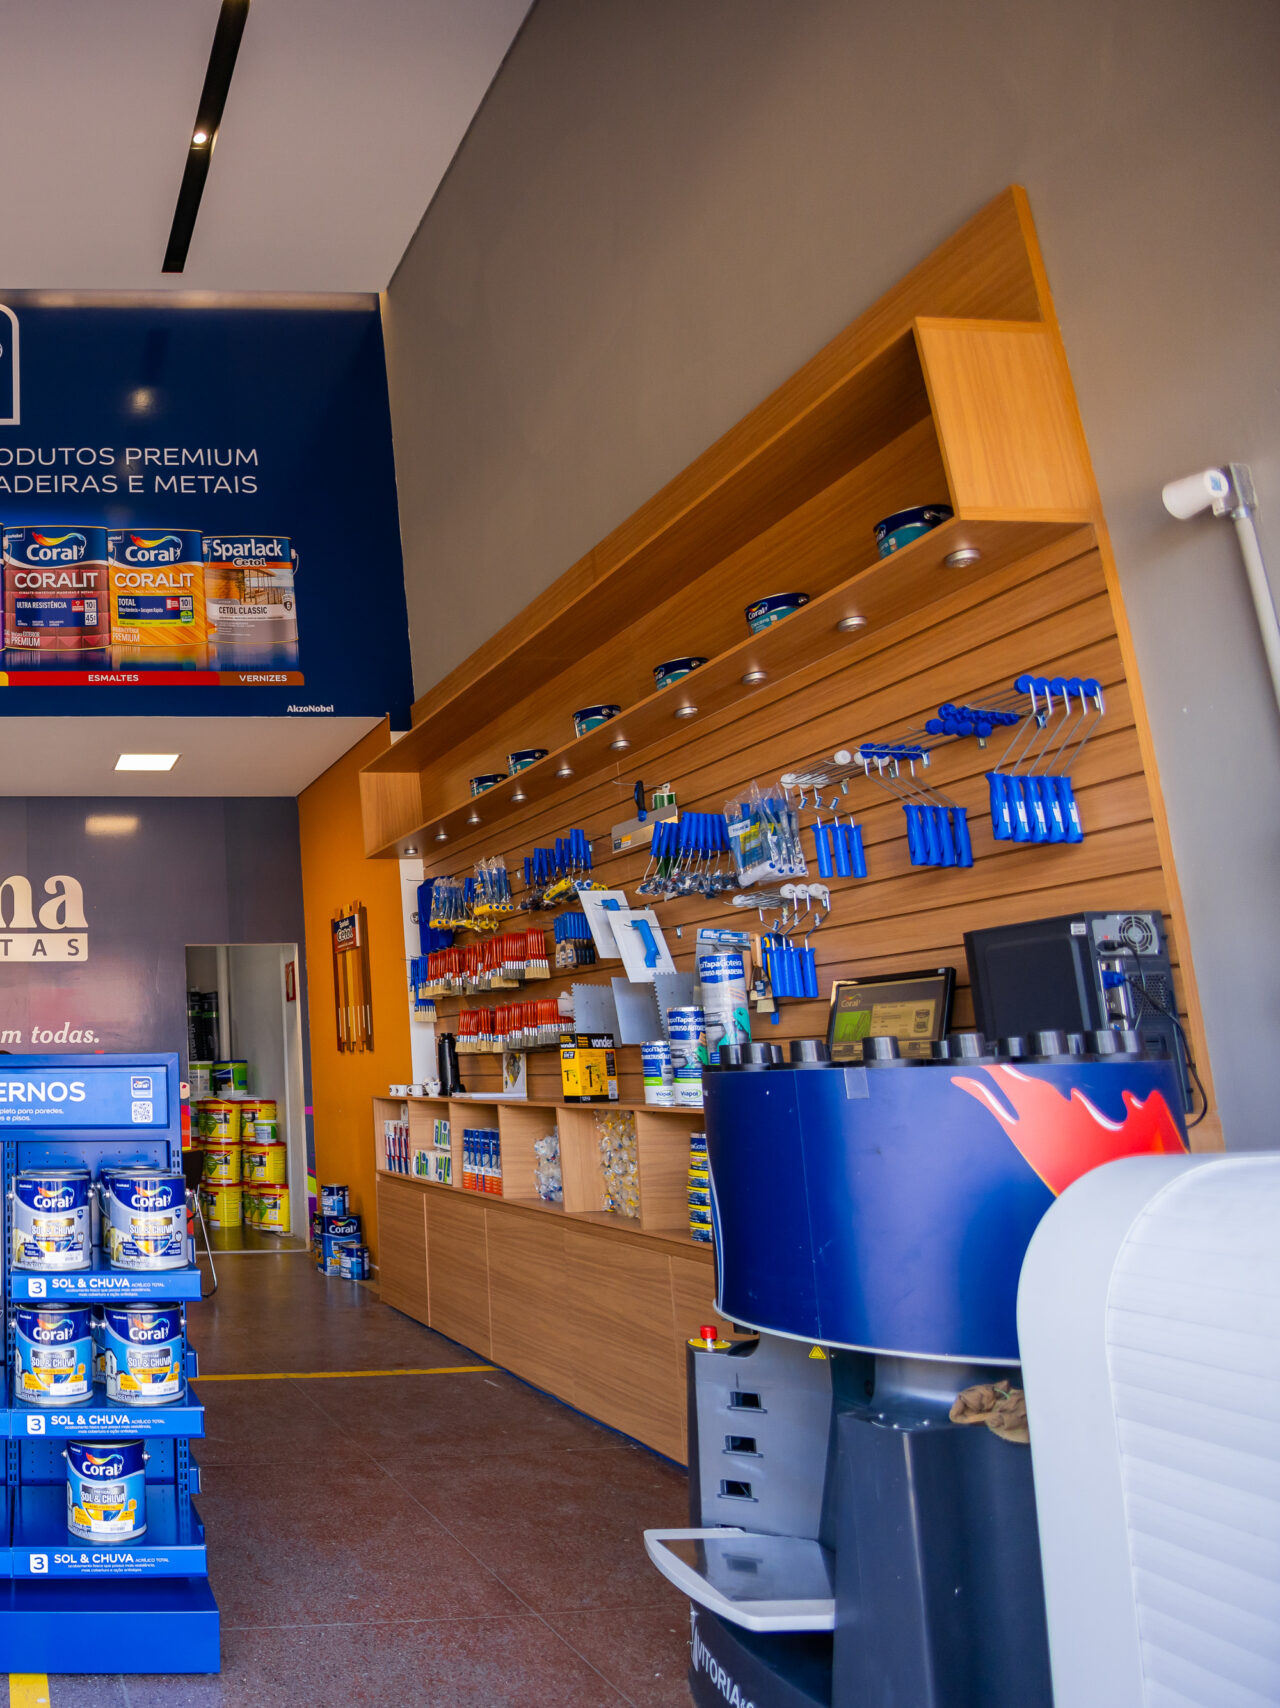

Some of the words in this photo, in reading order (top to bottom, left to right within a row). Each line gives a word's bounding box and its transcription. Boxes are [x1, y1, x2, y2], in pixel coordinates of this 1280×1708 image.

[125, 447, 259, 466] PREMIUM
[127, 475, 144, 493] E
[154, 475, 258, 494] METAIS
[26, 544, 78, 561] Coral
[125, 546, 175, 562] Coral
[212, 538, 283, 560] Sparlack
[232, 558, 267, 567] Cetol
[14, 572, 99, 589] CORALIT
[114, 572, 194, 589] CORALIT
[16, 601, 32, 609] ULTRA
[32, 599, 67, 609] RESISTÊNCIA
[118, 598, 136, 607] TOTAL
[218, 606, 238, 615] CETOL
[238, 606, 268, 615] CLASSIC
[88, 674, 139, 682] ESMALTES
[239, 674, 288, 682] VERNIZES
[287, 704, 334, 713] AkzoNobel
[31, 1021, 101, 1044] todas.
[591, 1036, 613, 1048] vonder
[680, 1090, 699, 1098] Viapol
[33, 1195, 69, 1208] Coral
[131, 1194, 167, 1208] Coral
[328, 1225, 354, 1234] Coral
[31, 1281, 42, 1294] 3
[51, 1278, 75, 1288] SOL
[77, 1278, 87, 1288] &
[89, 1278, 130, 1288] CHUVA
[32, 1327, 68, 1341] Coral
[128, 1327, 165, 1341] Coral
[30, 1418, 41, 1431] 3
[51, 1415, 74, 1425] SOL
[77, 1415, 86, 1425] &
[89, 1415, 130, 1425] CHUVA
[82, 1461, 118, 1476] Coral
[33, 1557, 45, 1570] 3
[54, 1553, 77, 1564] SOL
[80, 1553, 89, 1564] &
[92, 1553, 134, 1563] CHUVA
